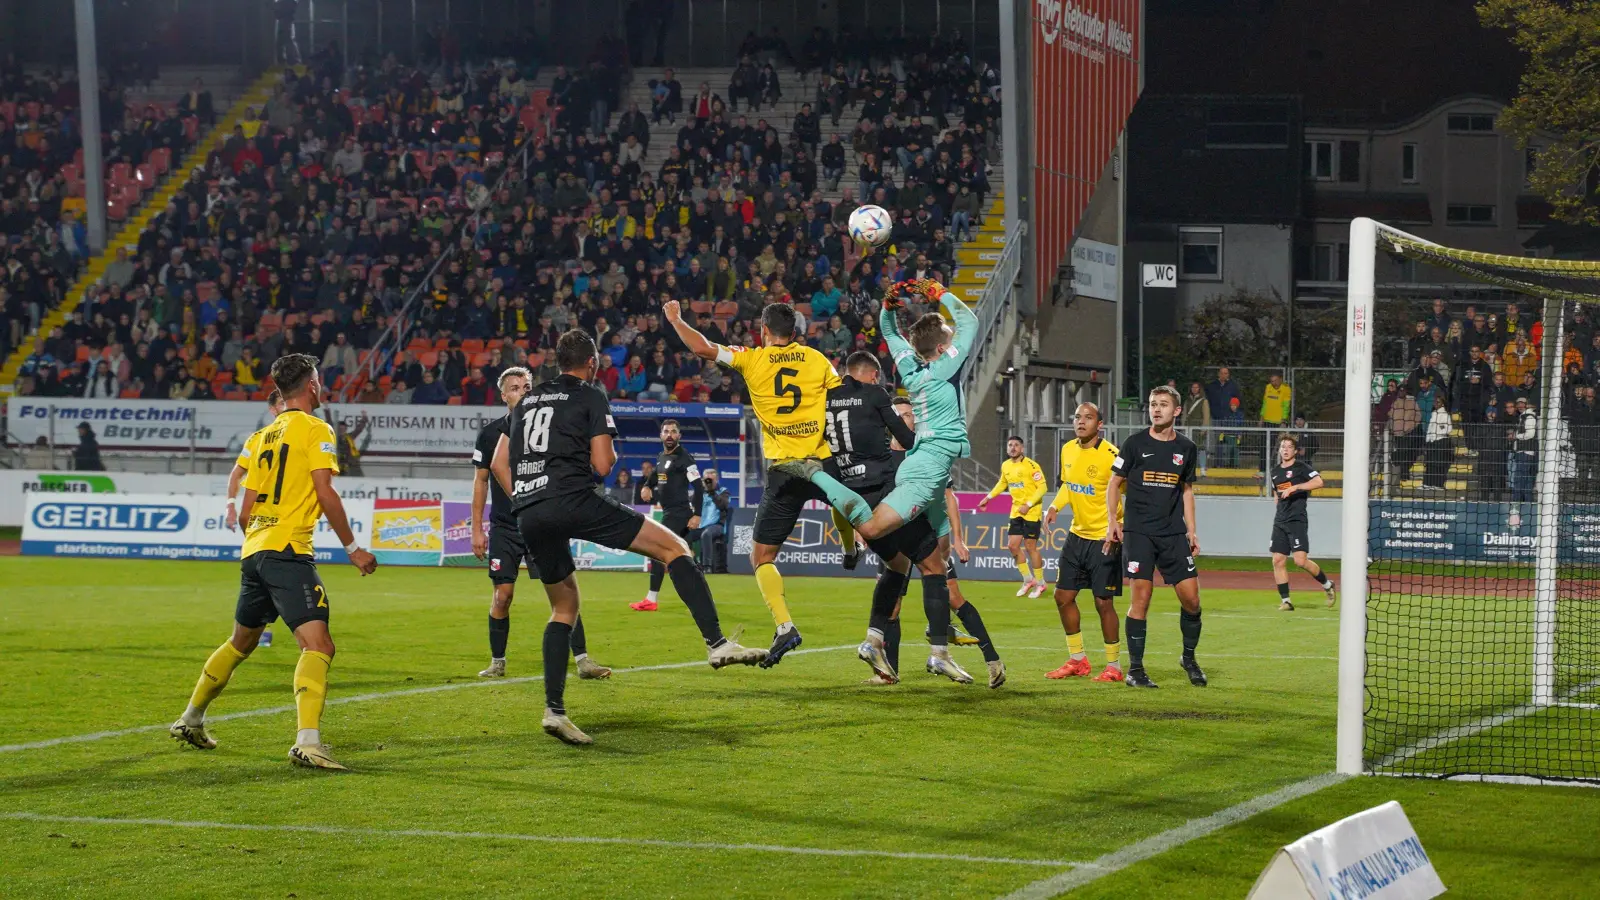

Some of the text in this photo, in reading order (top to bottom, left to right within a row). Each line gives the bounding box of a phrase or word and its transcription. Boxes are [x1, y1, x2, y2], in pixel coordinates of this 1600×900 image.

[1064, 0, 1105, 43] Gebrüder
[1107, 18, 1132, 55] Weiss
[1155, 266, 1174, 281] WC
[769, 352, 805, 363] SCHWARZ
[774, 367, 802, 414] 5
[831, 397, 862, 407] Hankofen
[19, 405, 193, 421] Formentechnik
[343, 415, 435, 429] GEMEINSAM
[440, 417, 455, 430] IN
[522, 406, 554, 454] 18
[103, 424, 213, 441] Bayreuth
[255, 443, 290, 505] 21
[517, 460, 545, 475] GÄNGER
[1143, 471, 1180, 483] ESB
[386, 487, 443, 500] Türen
[36, 504, 180, 530] GERLITZ
[1396, 512, 1428, 520] perfekte
[1416, 522, 1449, 530] optimale
[1396, 530, 1441, 539] betriebliche
[1483, 531, 1537, 547] Dallmay
[55, 543, 128, 555] starkstrom
[1385, 540, 1454, 550] Kaffeeversorgung
[774, 551, 843, 564] CHREINERE
